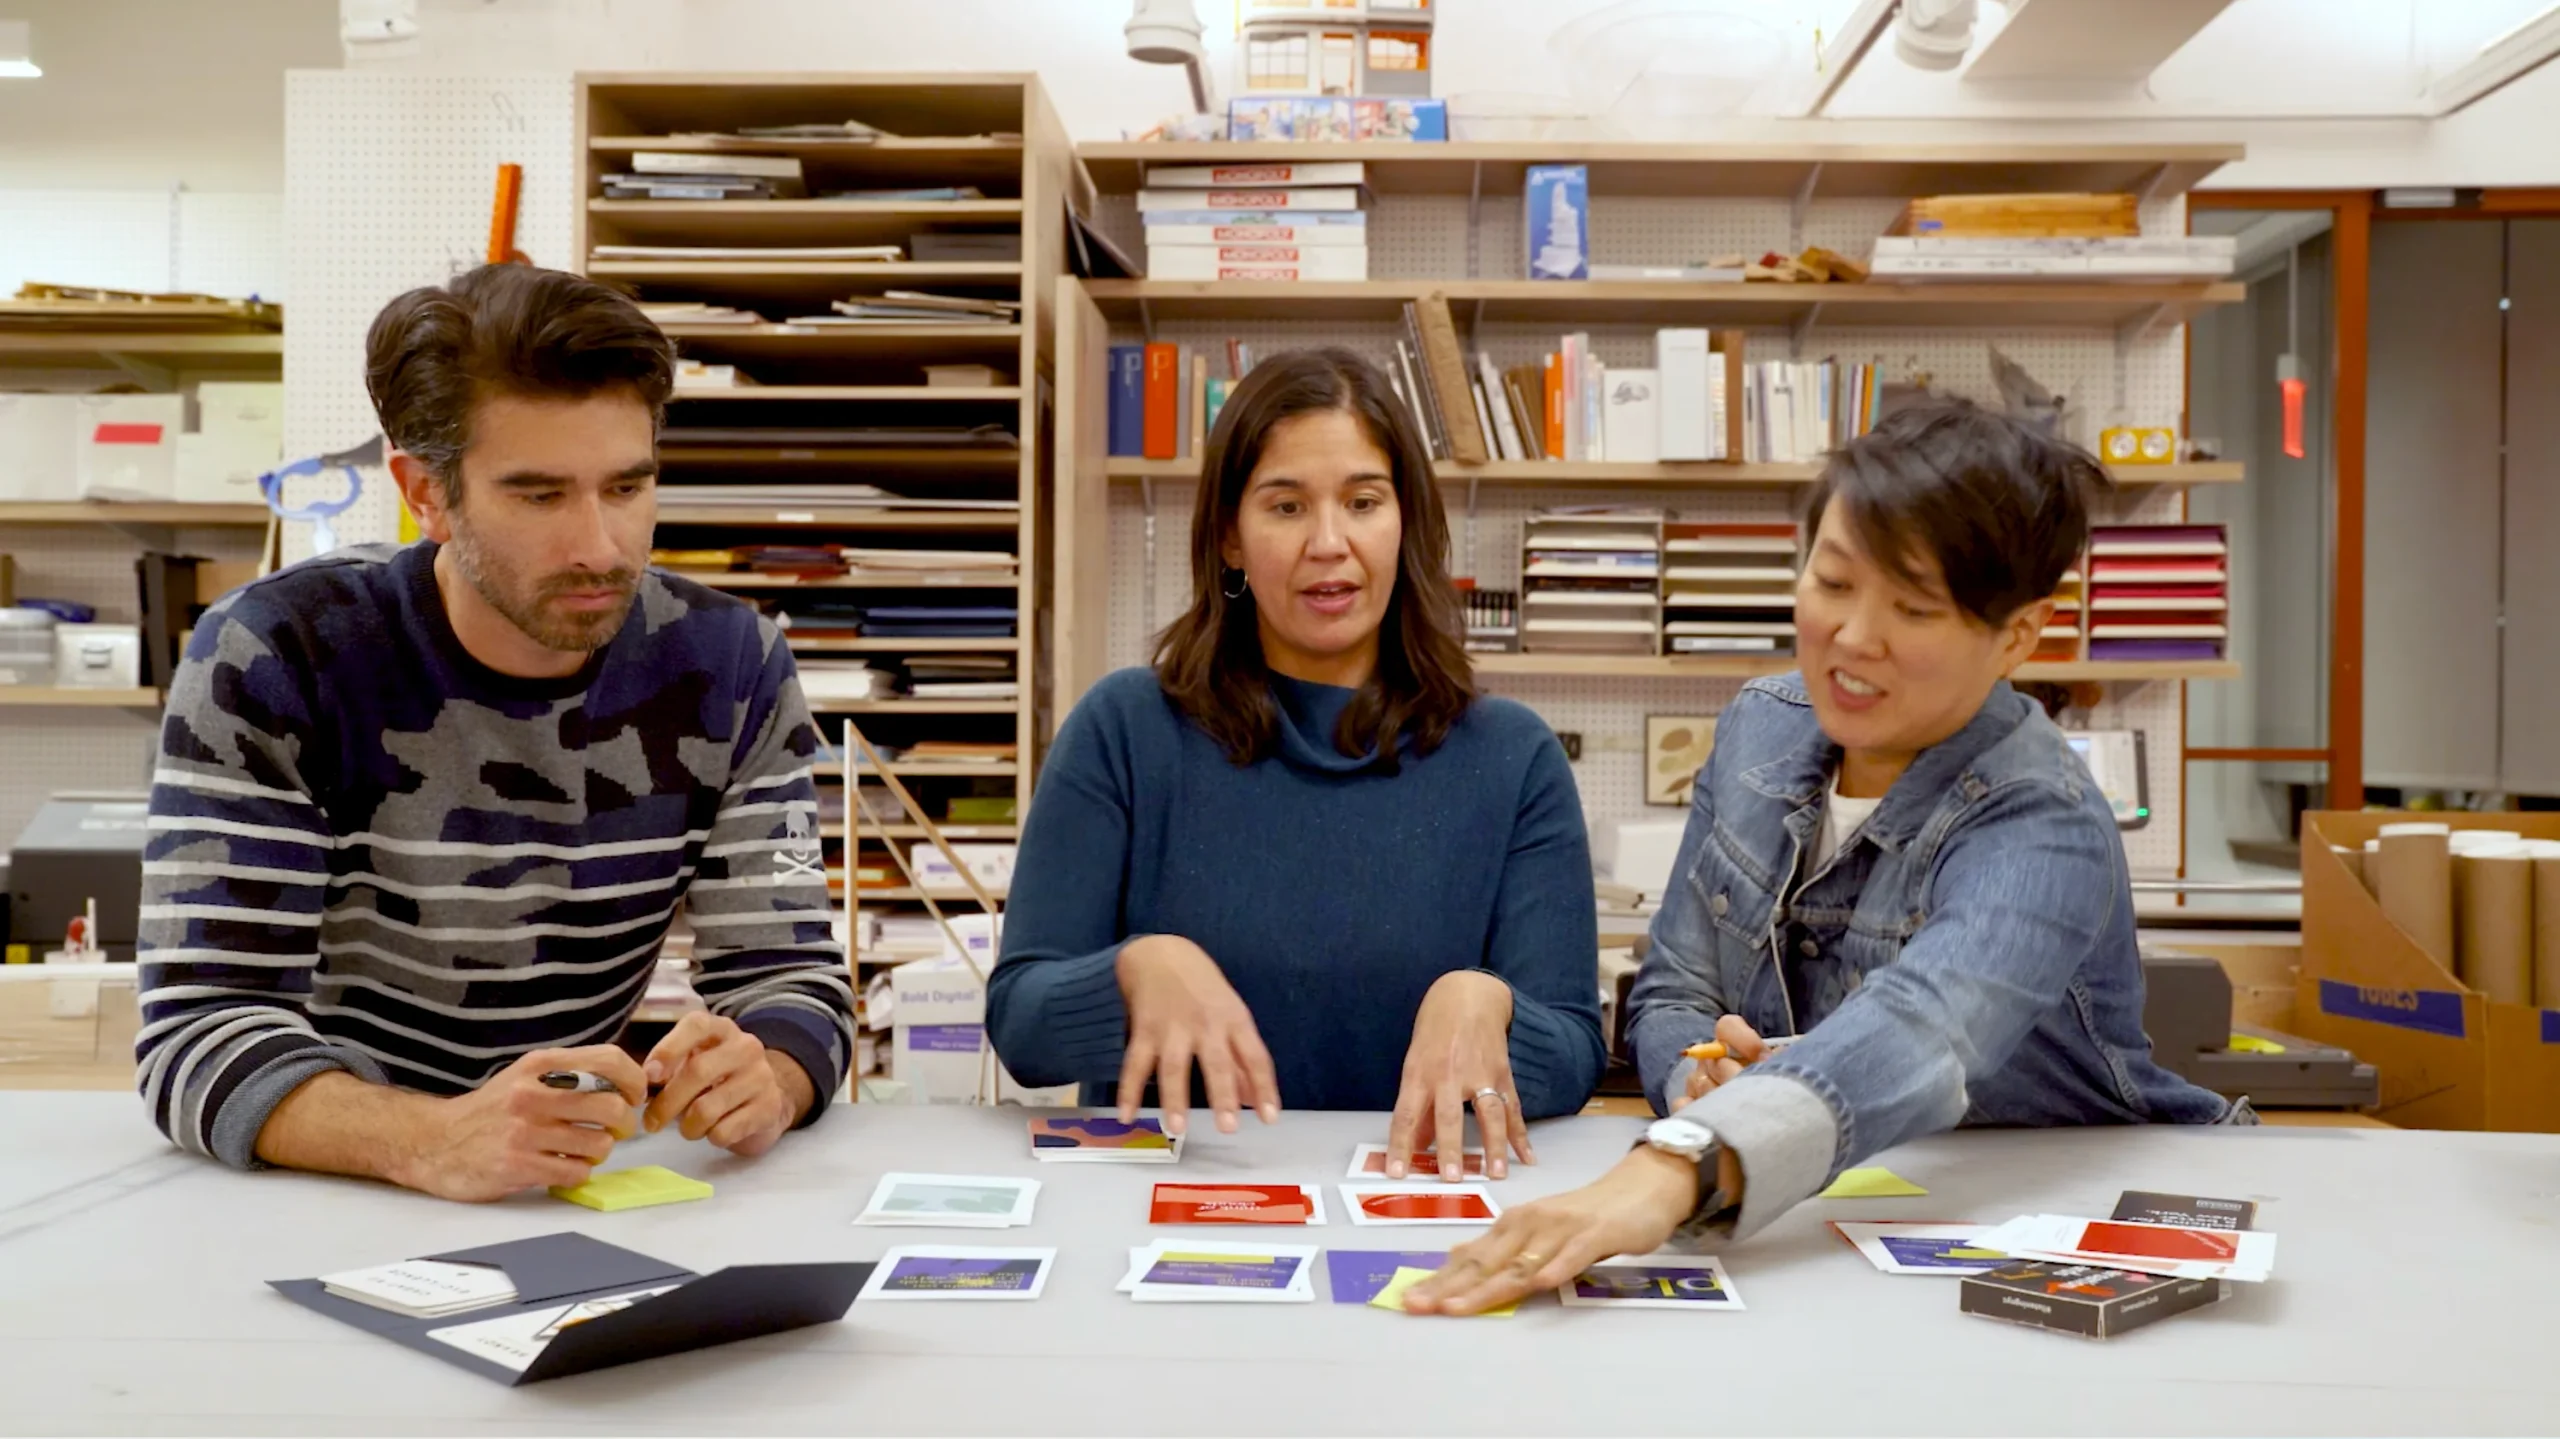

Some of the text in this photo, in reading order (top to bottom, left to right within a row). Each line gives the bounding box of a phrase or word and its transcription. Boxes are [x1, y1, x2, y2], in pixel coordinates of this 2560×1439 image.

[1214, 168, 1289, 182] MONOPOLY
[1209, 194, 1285, 206] MONOPOLY
[1215, 228, 1291, 240] MONOPOLY
[1221, 249, 1296, 261] MONOPOLY
[1220, 269, 1296, 280] MONOPOLY
[901, 991, 929, 1004] Bold
